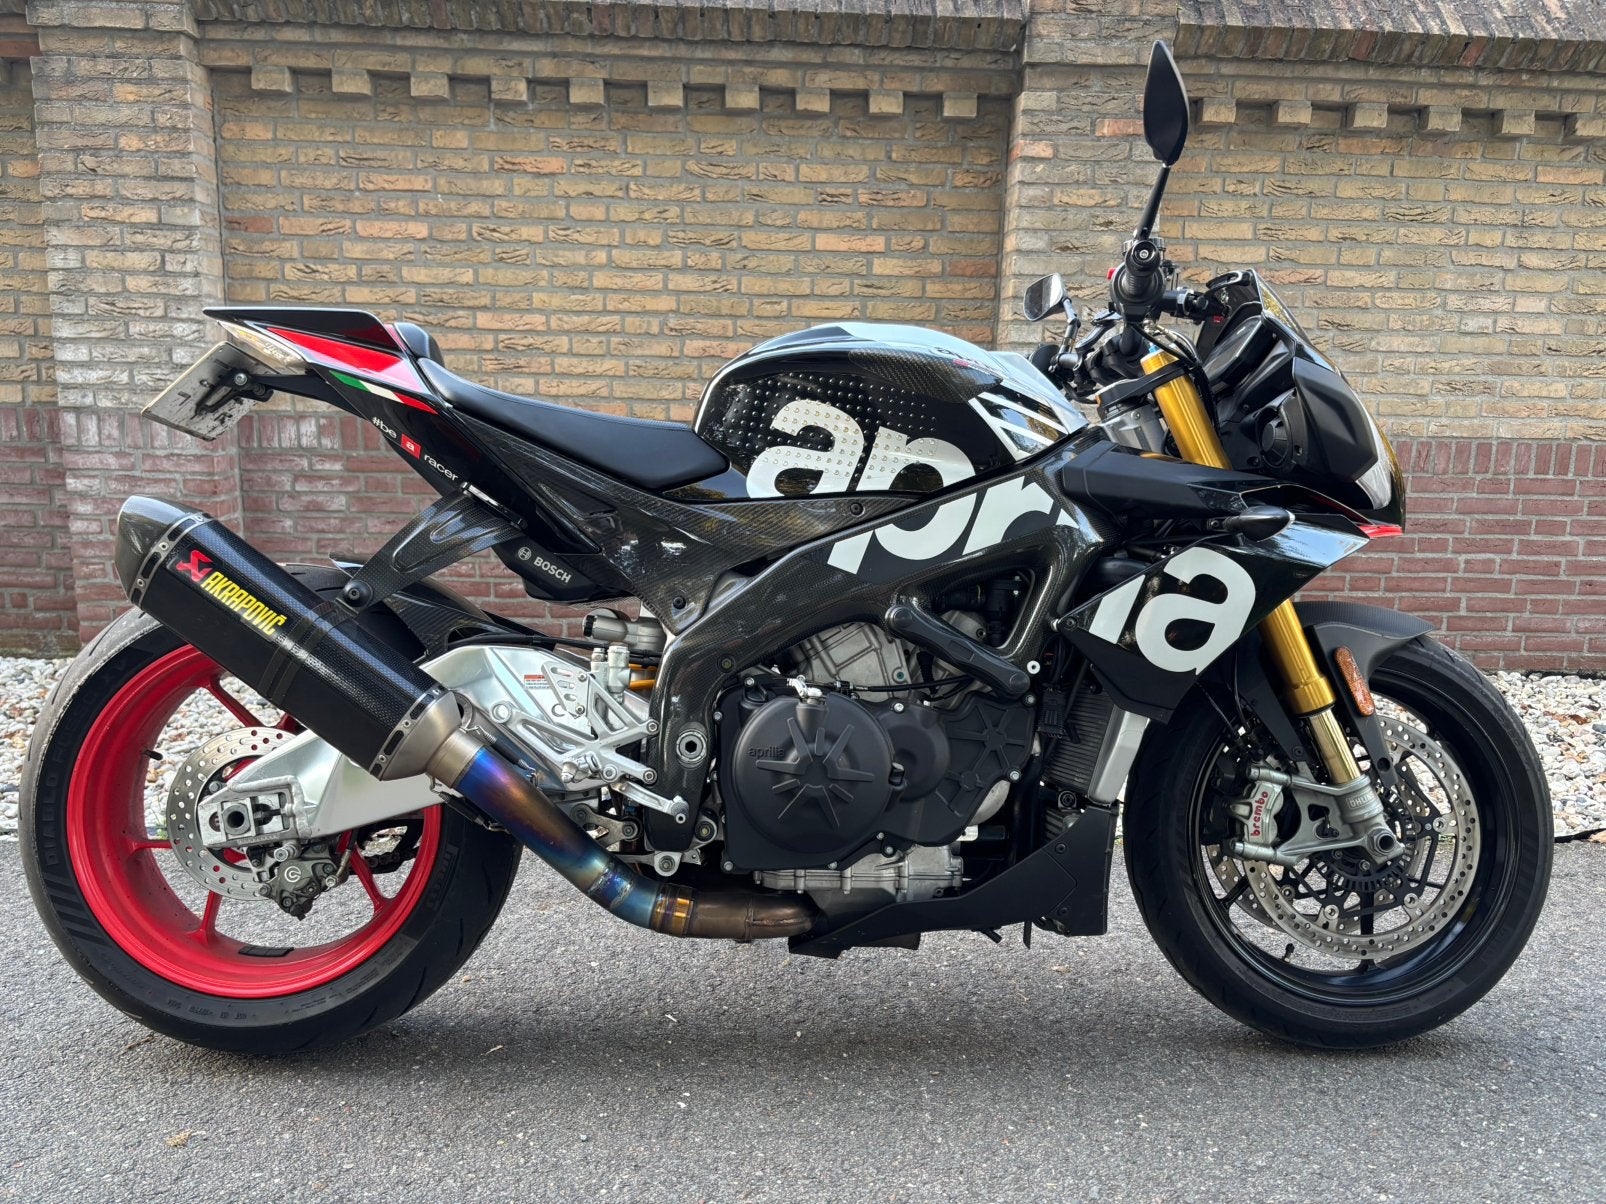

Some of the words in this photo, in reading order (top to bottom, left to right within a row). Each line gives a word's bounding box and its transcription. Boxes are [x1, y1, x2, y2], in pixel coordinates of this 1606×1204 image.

[372, 416, 397, 438] #be
[406, 441, 415, 452] a
[424, 454, 458, 481] racer
[533, 556, 572, 583] BOSCH
[748, 745, 784, 759] aprilia
[41, 772, 60, 867] DIABLO
[1240, 791, 1269, 837] brembo
